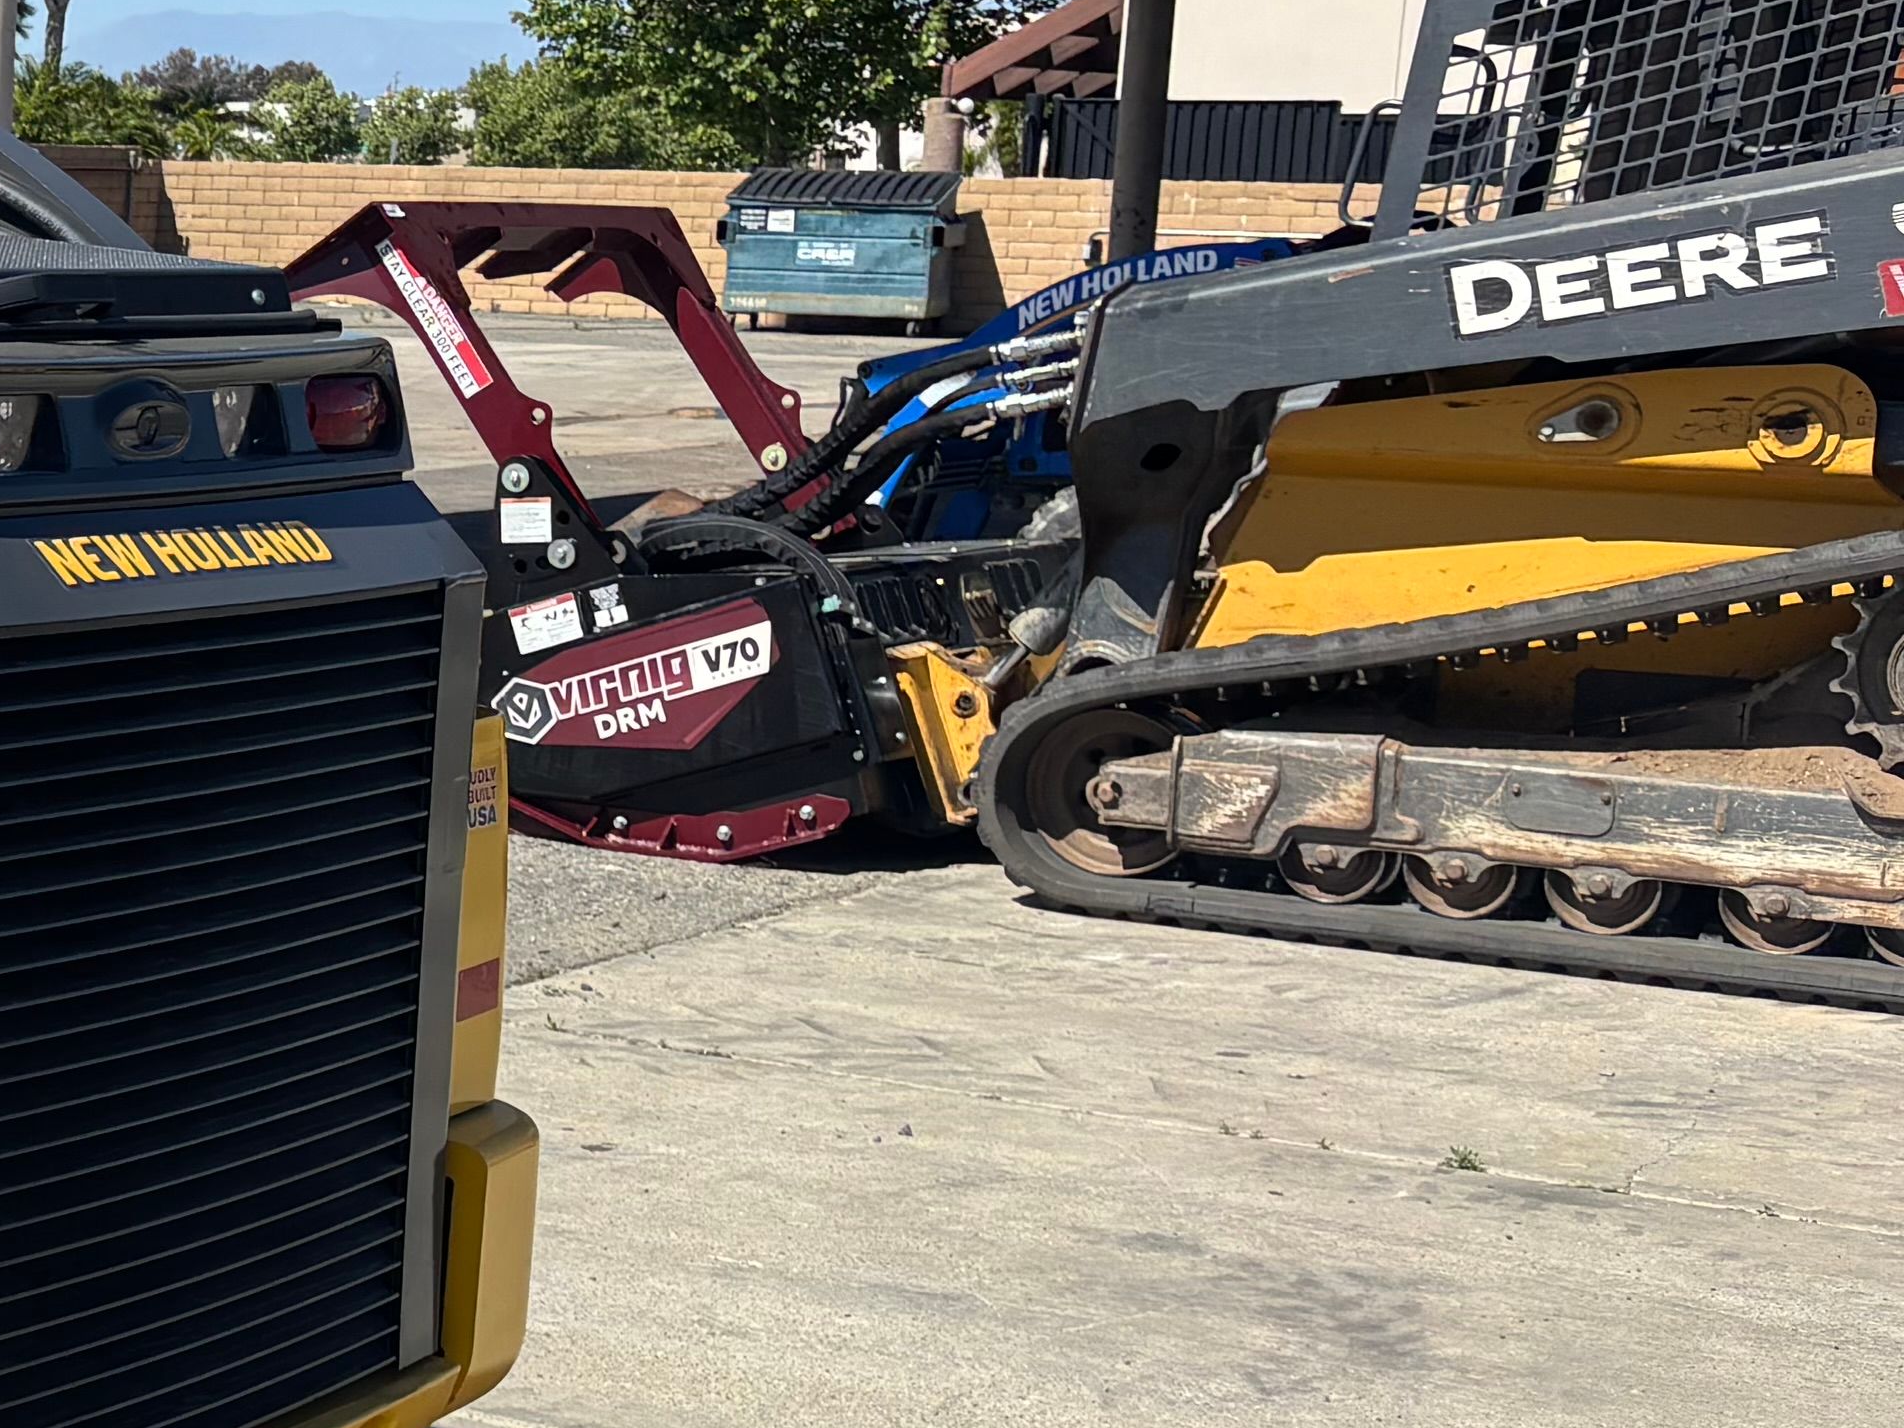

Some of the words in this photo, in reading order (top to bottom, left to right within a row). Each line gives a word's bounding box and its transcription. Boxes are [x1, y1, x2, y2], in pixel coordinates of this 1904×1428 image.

[1018, 279, 1076, 330] NEW
[1081, 249, 1218, 299] HOLLAND
[1450, 216, 1829, 335] DEERE
[379, 243, 405, 277] STAY
[402, 280, 436, 328] CLEAR
[431, 326, 452, 354] 300
[448, 352, 476, 390] FEET
[423, 285, 466, 347] DANGER
[34, 532, 156, 586] NEW
[142, 521, 333, 573] HOLLAND
[701, 637, 759, 673] V70
[594, 698, 667, 740] DRM
[468, 786, 496, 803] BUILT
[468, 803, 496, 828] USA
